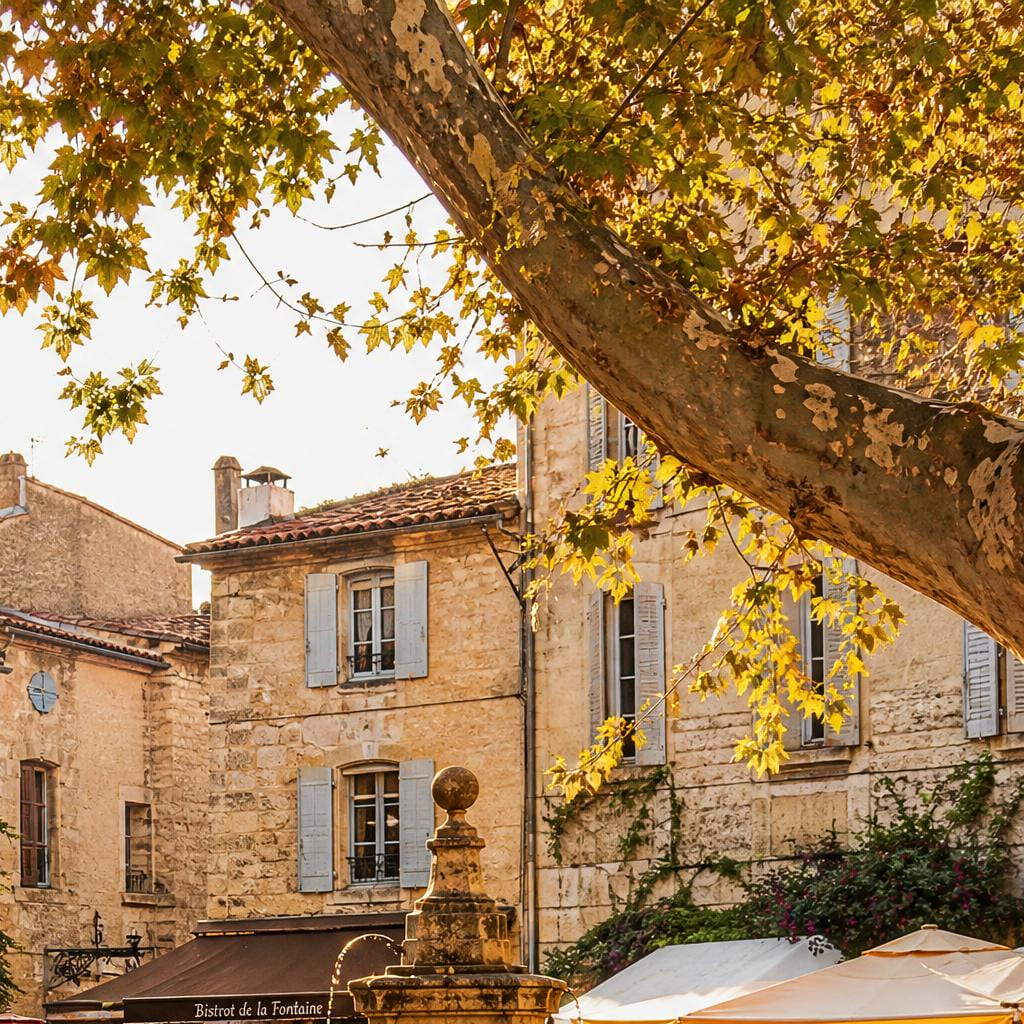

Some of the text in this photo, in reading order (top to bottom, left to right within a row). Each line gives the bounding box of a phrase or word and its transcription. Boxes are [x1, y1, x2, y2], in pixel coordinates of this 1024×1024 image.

[194, 1000, 324, 1018] Bistrot de la Fontaine
